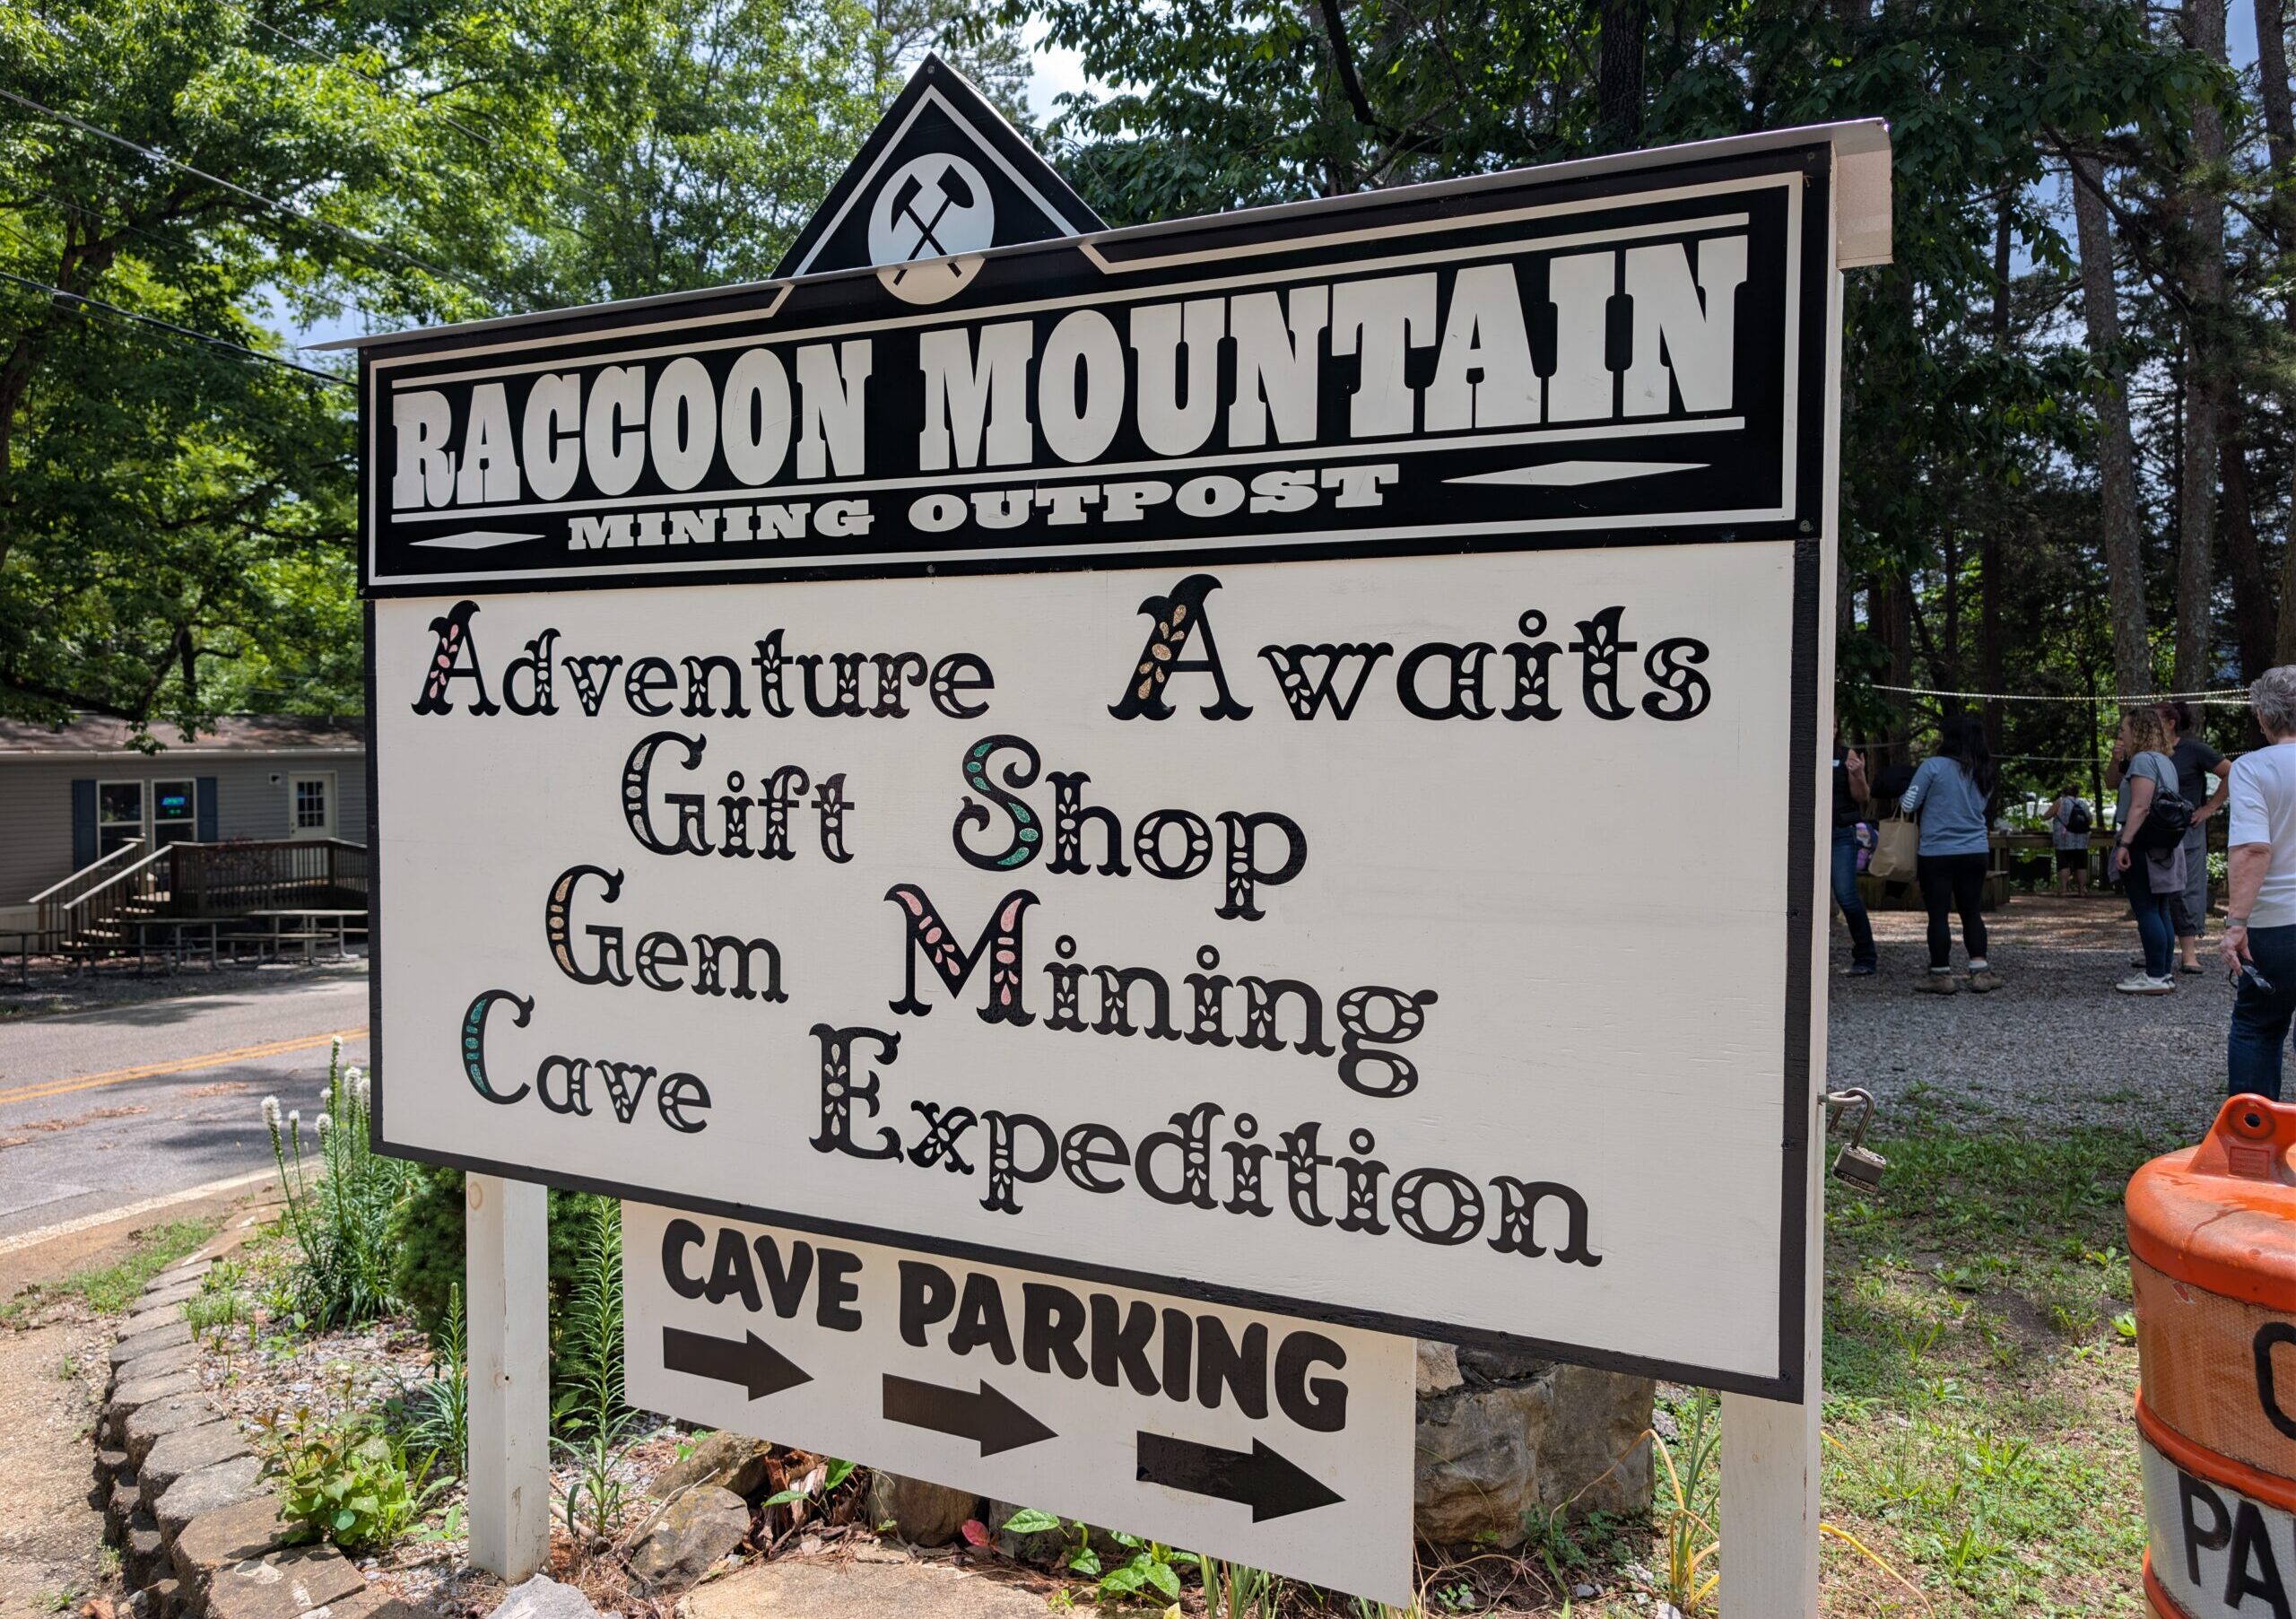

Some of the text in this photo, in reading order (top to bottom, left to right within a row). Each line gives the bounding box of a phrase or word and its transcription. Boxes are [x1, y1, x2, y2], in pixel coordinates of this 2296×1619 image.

[392, 234, 1748, 509] RACCOON MOUNTAIN
[568, 463, 1399, 551] MINING OUTPOST
[411, 573, 1711, 722] Adventure Awaits
[621, 730, 1308, 922] Gift Shop
[544, 864, 1439, 1099] Gem Mining
[461, 988, 1603, 1267] Cave Expedition
[661, 1218, 1349, 1433] CAVE PARKING
[2177, 1468, 2296, 1619] PA
